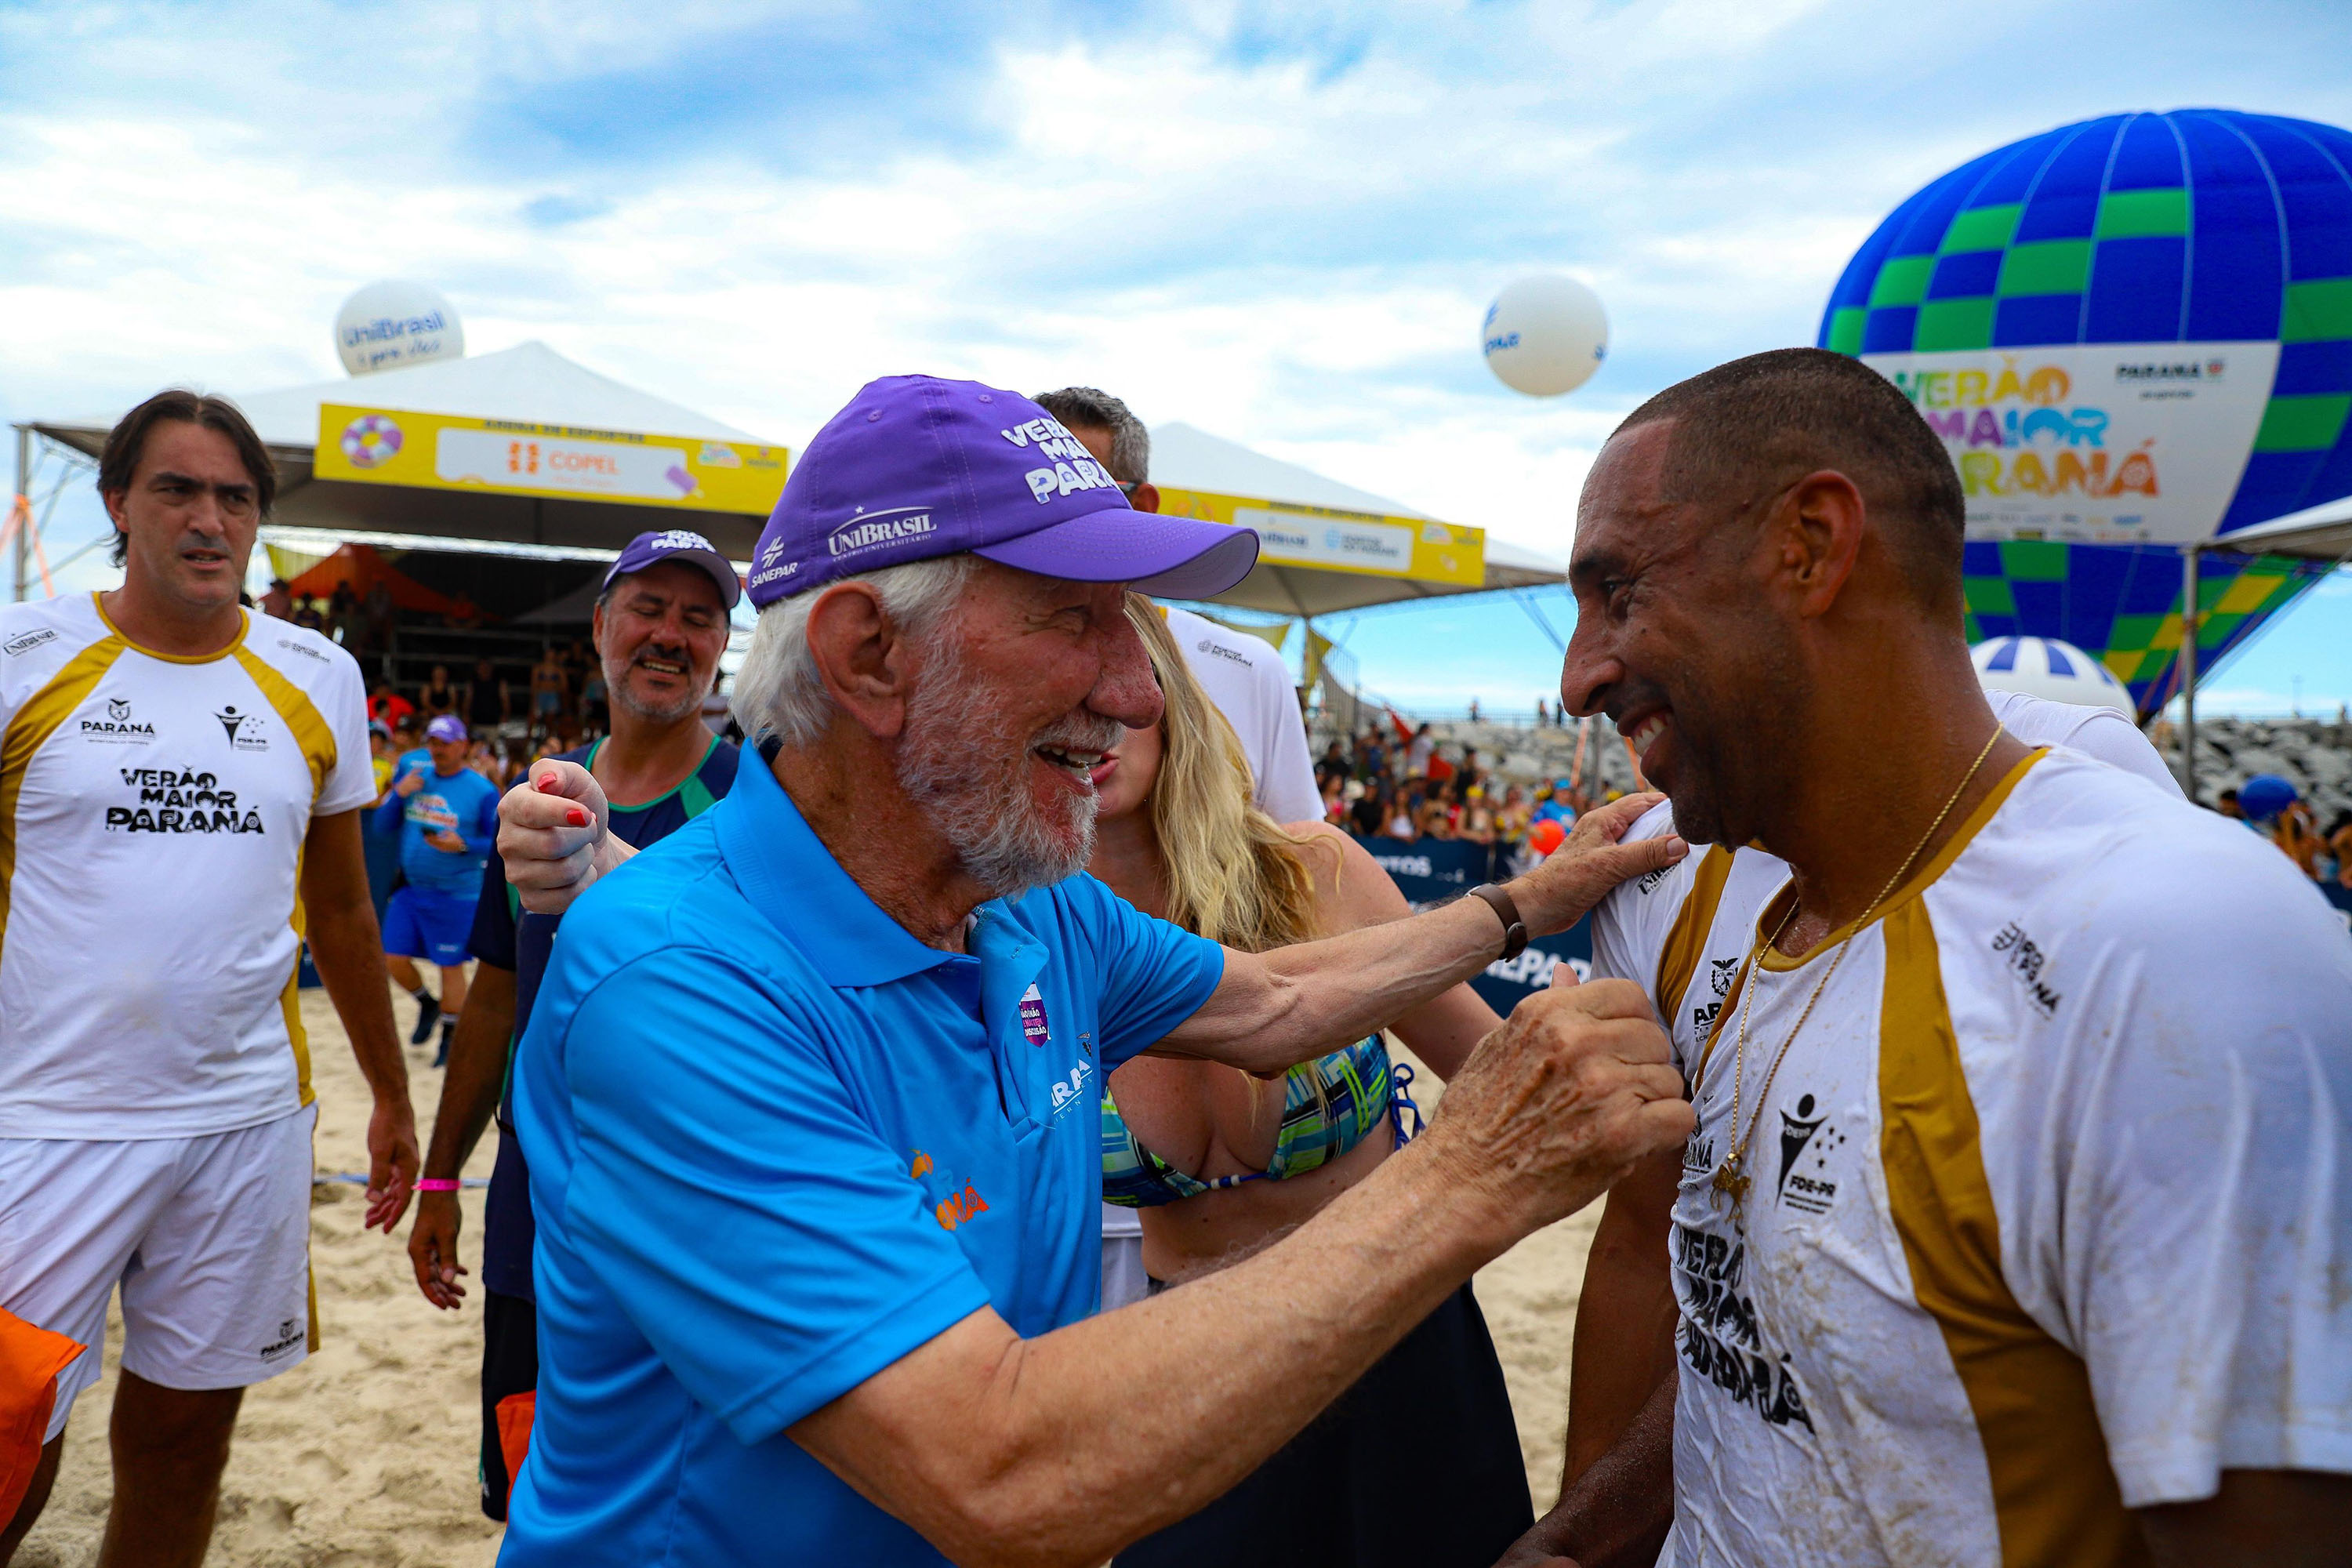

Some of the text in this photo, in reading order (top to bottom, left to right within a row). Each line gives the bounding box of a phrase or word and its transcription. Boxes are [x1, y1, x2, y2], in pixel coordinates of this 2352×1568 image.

[550, 451, 619, 474] COPEL
[1961, 437, 2160, 499] RANÁ
[751, 562, 798, 589] SANEPAR
[82, 721, 154, 734] PARANÁ
[121, 764, 217, 788] VERÃO
[141, 789, 236, 808] MAIOR
[105, 805, 264, 833] PARANÁ
[1789, 1175, 1836, 1198] FDE-PR
[936, 1177, 989, 1231] ANÁ
